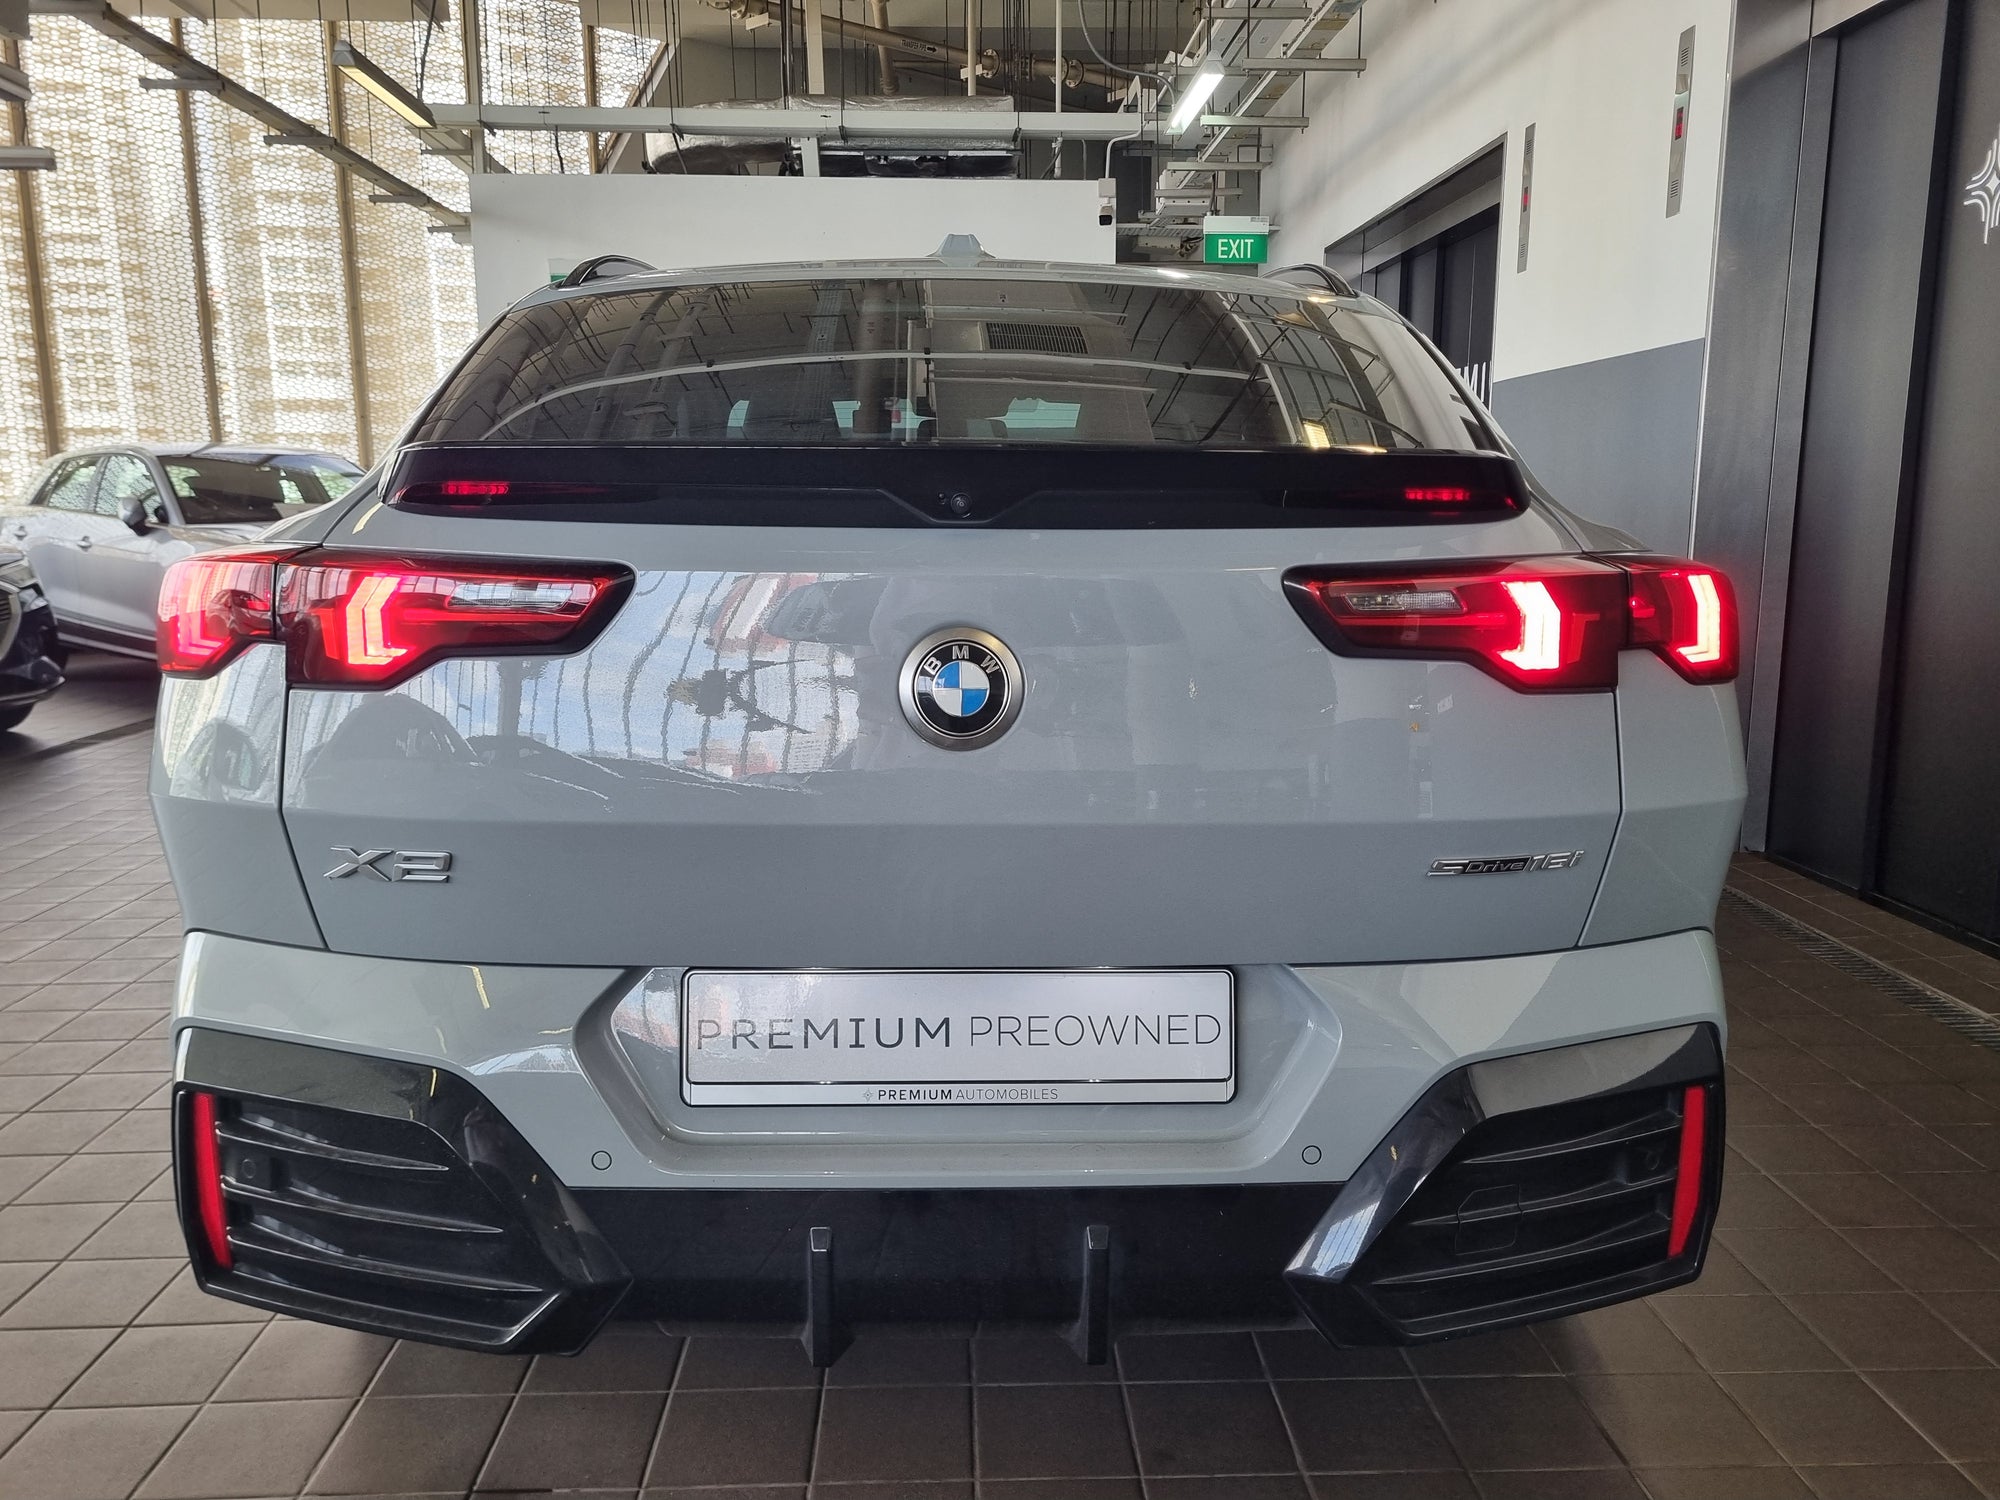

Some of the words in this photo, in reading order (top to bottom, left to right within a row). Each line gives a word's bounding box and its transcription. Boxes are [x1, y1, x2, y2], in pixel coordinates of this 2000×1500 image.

[1218, 239, 1254, 258] EXIT
[923, 645, 1000, 675] BMW
[323, 845, 452, 882] X2
[697, 1017, 950, 1050] PREMIUM
[970, 1014, 1221, 1047] PREOWNED
